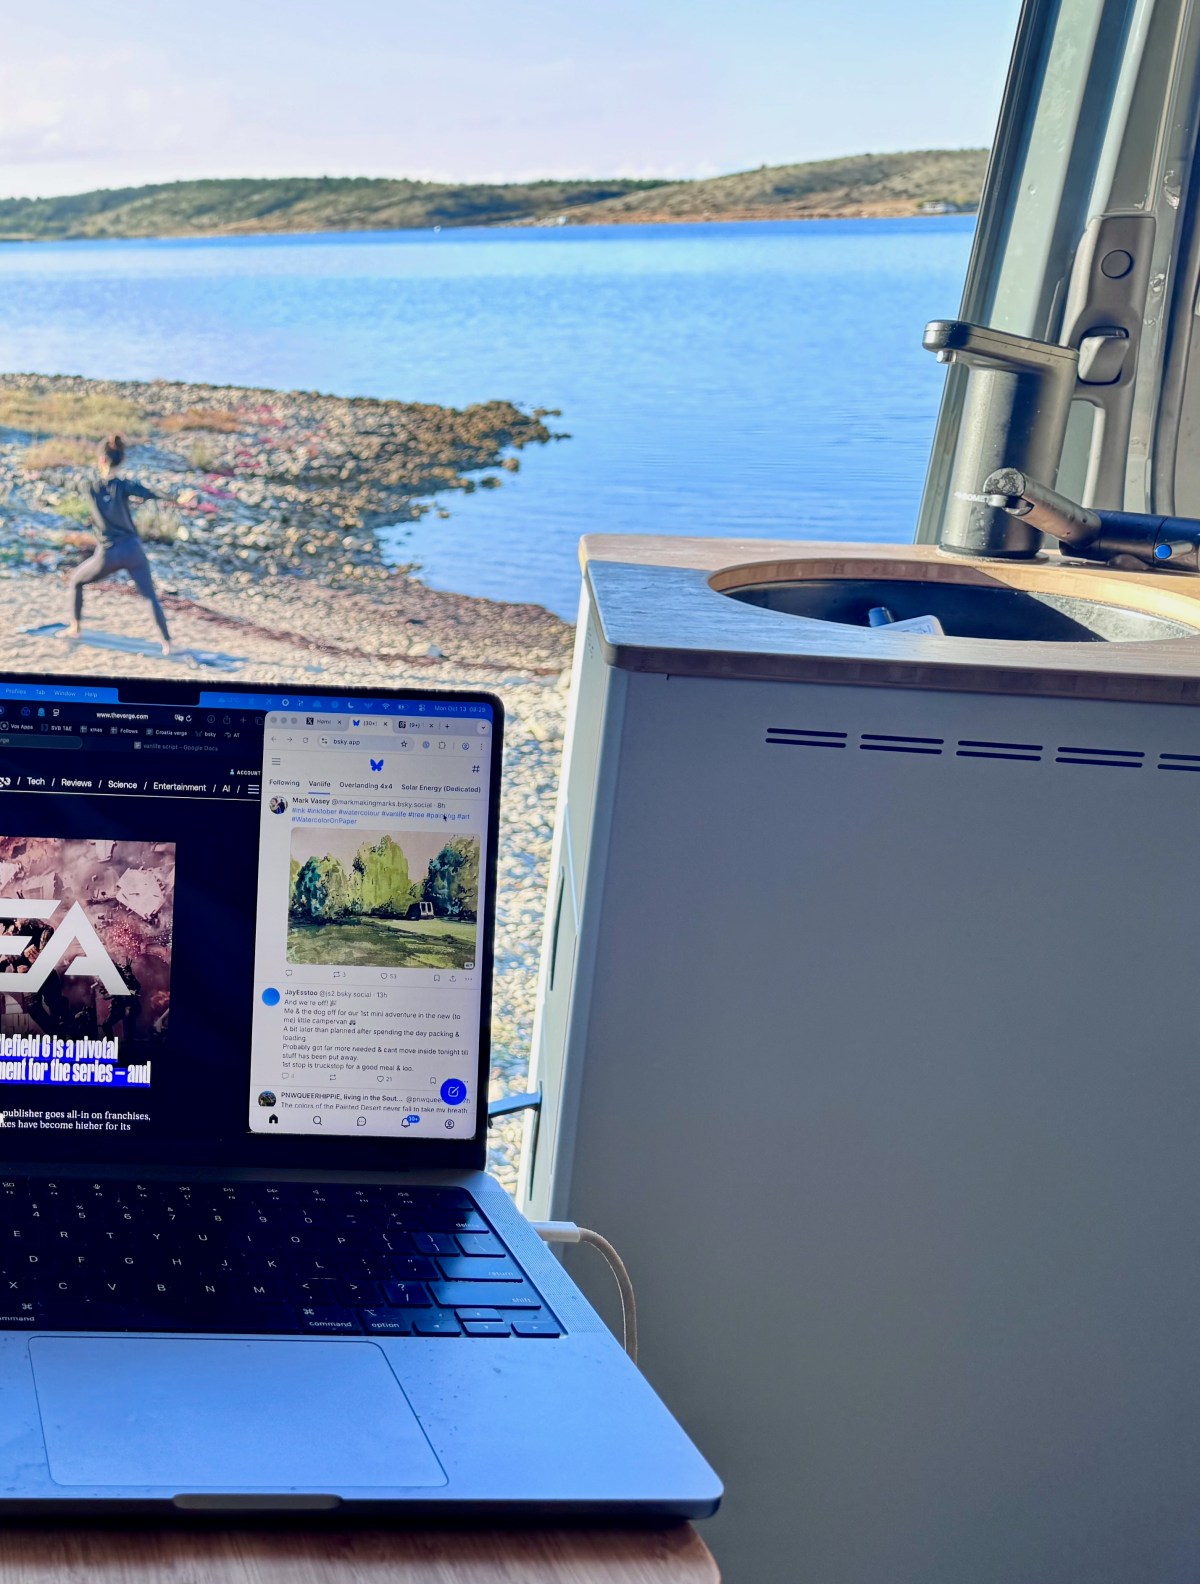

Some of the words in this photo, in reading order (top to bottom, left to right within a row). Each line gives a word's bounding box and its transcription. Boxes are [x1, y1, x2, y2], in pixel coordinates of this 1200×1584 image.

[96, 712, 148, 720] www.theverge.com
[334, 738, 360, 746] bsky.app
[26, 776, 46, 786] Tech
[61, 778, 92, 788] Reviews
[108, 780, 138, 790] Science
[153, 782, 206, 793] Entertainment
[222, 784, 231, 792] AI
[269, 779, 300, 788] Following
[308, 780, 331, 788] Vanlife
[340, 782, 378, 790] Overlanding
[420, 784, 442, 792] Energy
[444, 786, 480, 794] (Dedicated)
[310, 798, 330, 806] Vasey
[292, 816, 357, 825] #WatercolorOnPaper
[312, 1018, 347, 1026] campervan
[416, 1030, 427, 1038] day
[42, 1034, 50, 1058] 6
[52, 1035, 64, 1058] is
[66, 1039, 74, 1059] a
[76, 1036, 118, 1061] pivotal
[28, 1058, 48, 1081] for
[50, 1059, 70, 1082] the
[72, 1060, 112, 1083] series
[128, 1061, 151, 1084] and
[344, 1094, 360, 1102] living
[3, 1108, 42, 1120] publisher
[45, 1112, 64, 1120] goes
[67, 1110, 90, 1120] all-in
[92, 1112, 102, 1120] on
[104, 1111, 150, 1121] franchises,
[18, 1120, 37, 1129] have
[40, 1120, 73, 1130] become
[76, 1121, 102, 1130] higher
[105, 1122, 118, 1130] for
[120, 1122, 131, 1130] its
[309, 1320, 352, 1328] command
[371, 1321, 400, 1330] option
